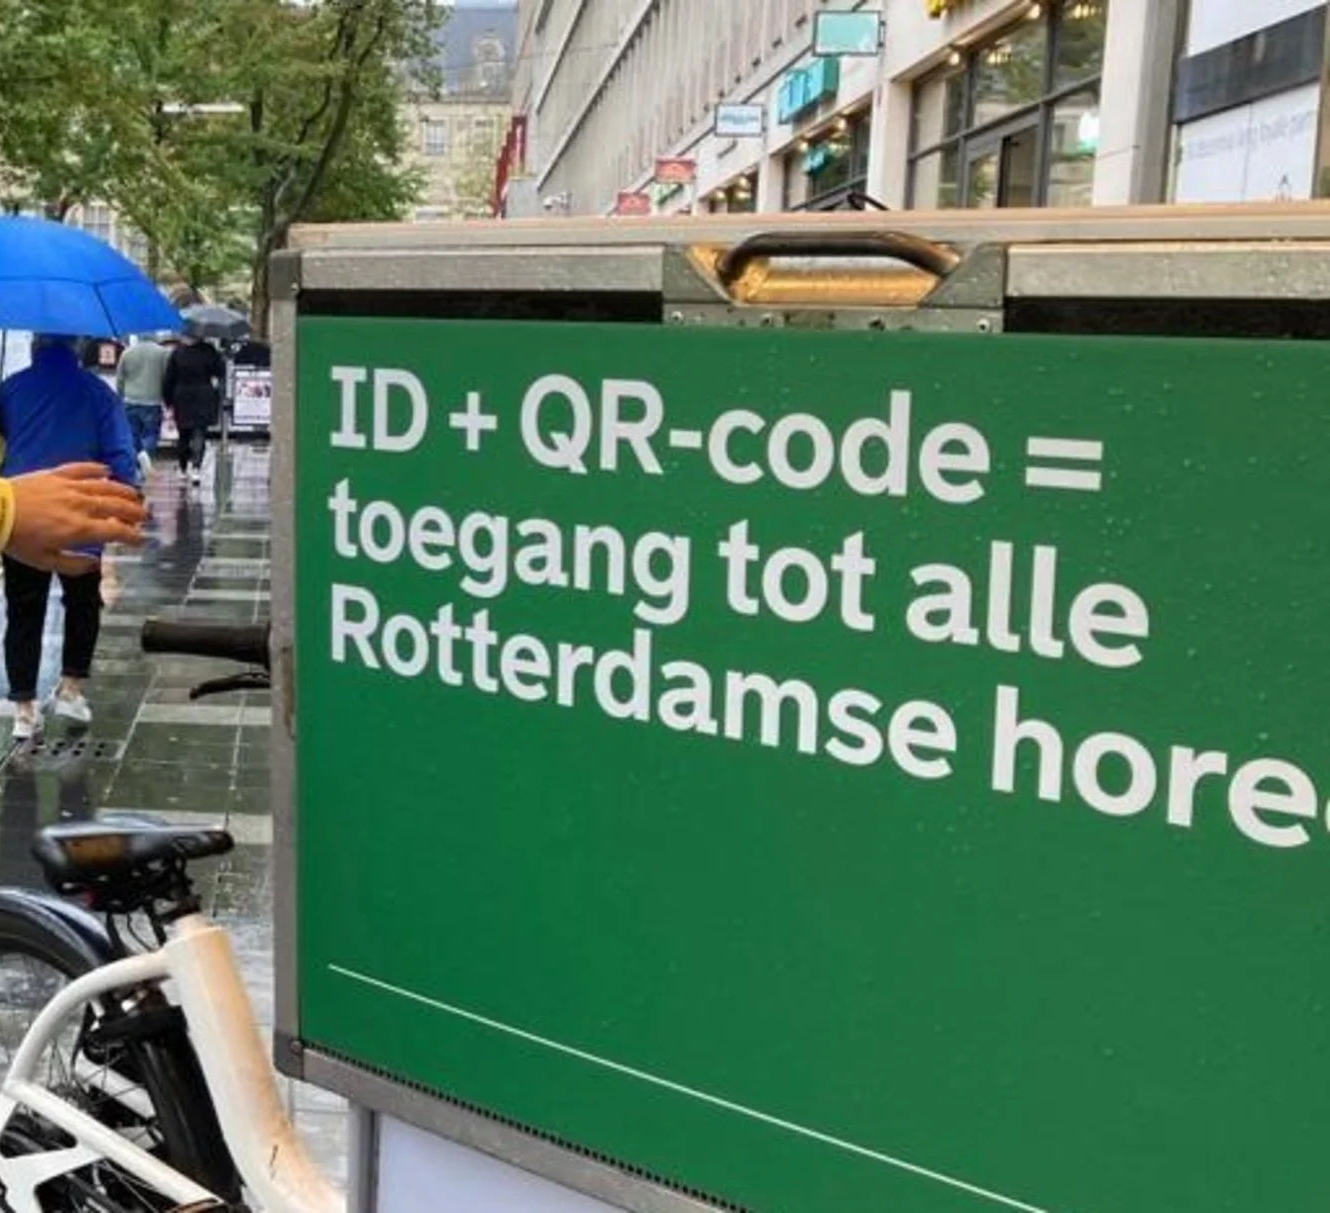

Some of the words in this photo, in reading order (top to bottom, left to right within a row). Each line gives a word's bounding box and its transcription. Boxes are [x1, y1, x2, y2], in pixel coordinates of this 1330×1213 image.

[330, 366, 428, 452] ID
[449, 391, 497, 452] +
[520, 374, 990, 503] QR-code
[1025, 437, 1103, 491] =
[328, 479, 690, 625] toegang
[718, 519, 876, 632] tot
[905, 540, 1150, 669] alle
[331, 583, 957, 780] Rotterdamse
[990, 685, 1330, 849] hore
